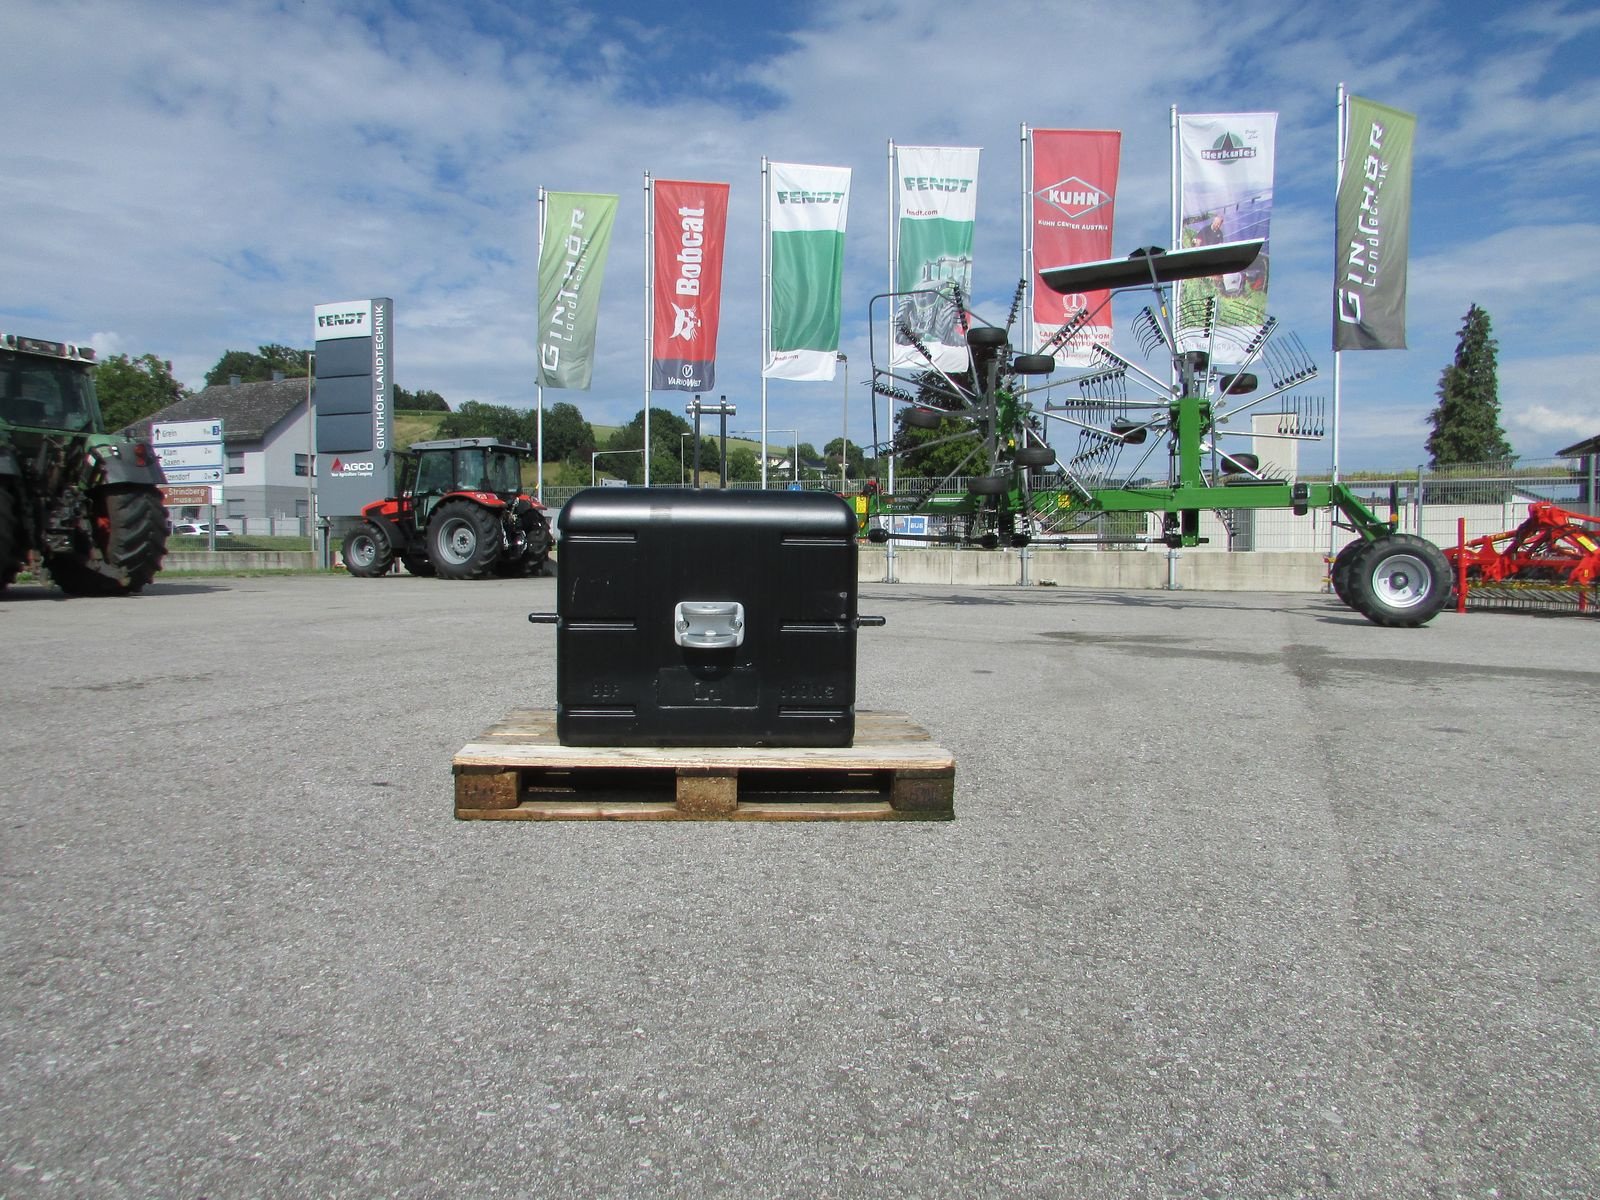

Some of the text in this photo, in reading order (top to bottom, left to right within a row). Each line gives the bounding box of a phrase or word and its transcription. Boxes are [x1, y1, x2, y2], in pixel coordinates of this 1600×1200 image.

[1201, 149, 1256, 160] Herkules
[903, 177, 973, 193] FENDT
[777, 191, 845, 205] FENDT
[1049, 189, 1100, 206] KUHN
[1038, 219, 1055, 227] KUHN
[1057, 221, 1080, 229] CENTER
[675, 206, 705, 296] Bobcat
[542, 208, 585, 371] GINTHÖR
[318, 312, 366, 327] FENDT
[374, 304, 385, 450] GINTHÖR LANDTECHNIK
[343, 462, 374, 471] AGCO
